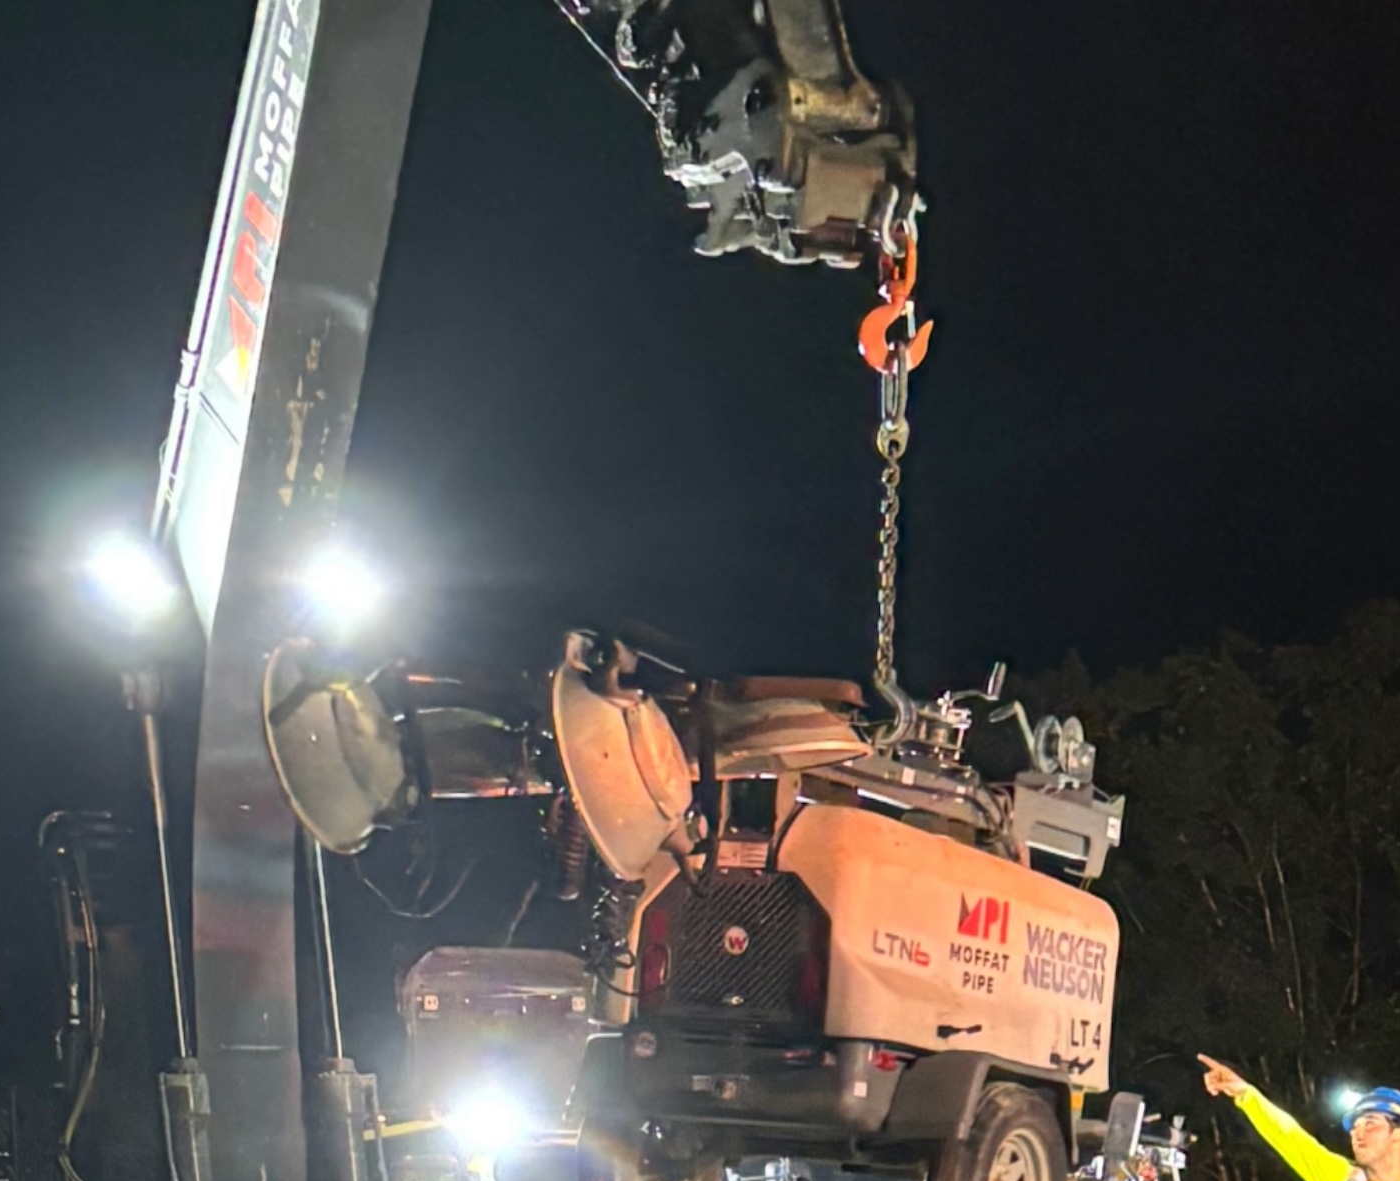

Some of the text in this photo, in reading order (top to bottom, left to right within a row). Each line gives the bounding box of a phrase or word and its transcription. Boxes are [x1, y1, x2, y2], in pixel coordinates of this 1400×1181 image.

[957, 892, 1010, 945] MPI
[949, 943, 1010, 973] MOFFAT
[1026, 922, 1108, 972] WACKER
[962, 972, 994, 995] PIPE
[1023, 955, 1106, 1005] NEUSON
[1071, 1018, 1102, 1051] LT 4
